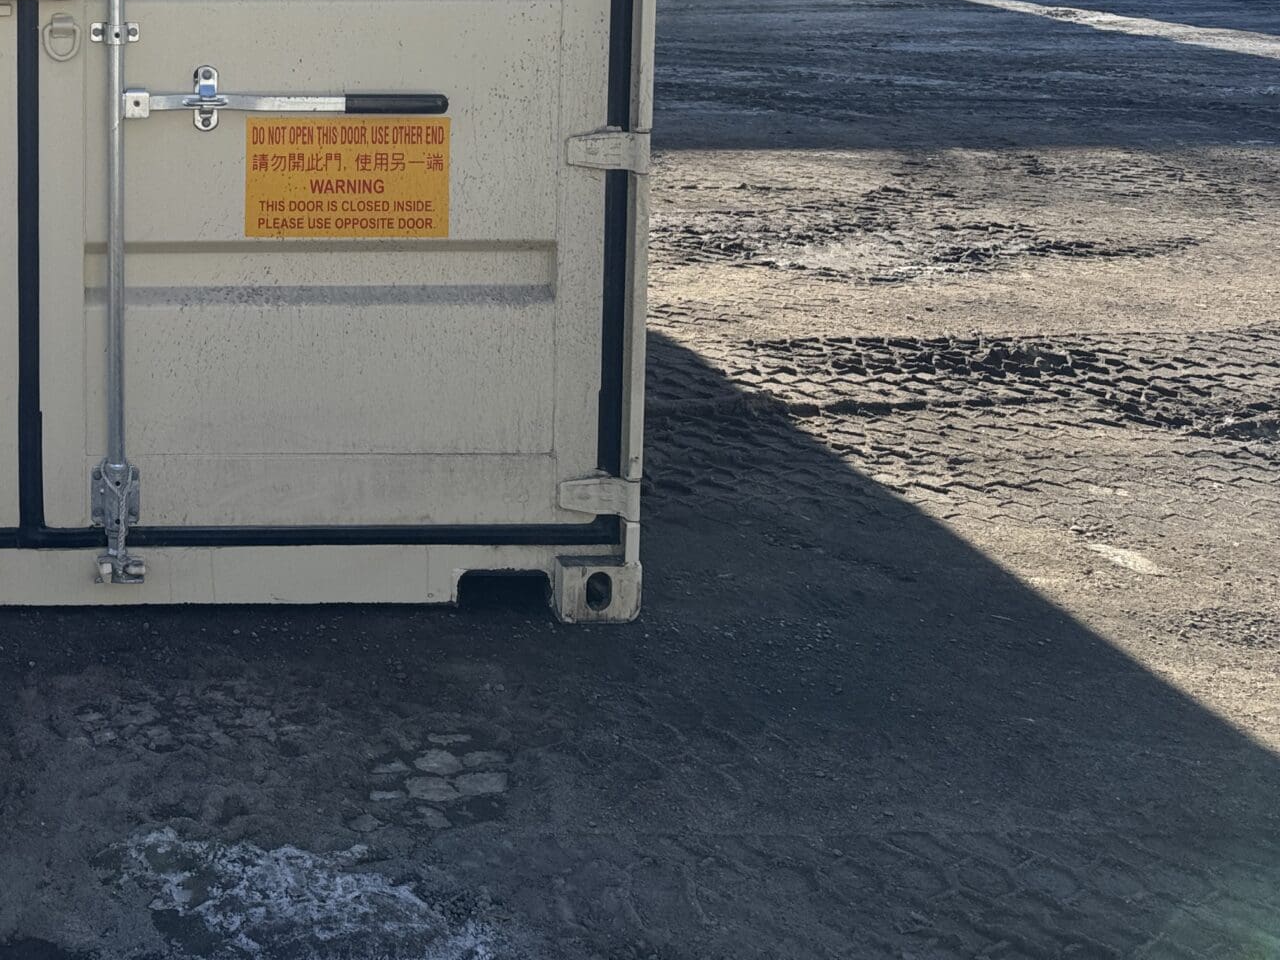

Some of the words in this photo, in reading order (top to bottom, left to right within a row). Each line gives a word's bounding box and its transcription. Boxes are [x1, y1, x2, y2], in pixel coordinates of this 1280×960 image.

[252, 126, 264, 145] DO
[268, 126, 285, 145] NOT
[289, 126, 314, 145] OPEN
[317, 126, 337, 145] THIS
[372, 126, 389, 145] USE
[392, 126, 423, 145] OTHER
[310, 179, 385, 194] WARNING
[259, 200, 285, 212] THIS
[289, 200, 323, 212] DOOR
[327, 200, 338, 212] IS
[341, 200, 390, 212] CLOSED
[393, 200, 436, 212] INSIDE.
[258, 217, 304, 229] PLEASE
[308, 217, 331, 229] USE
[335, 217, 394, 229] OPPOSITE
